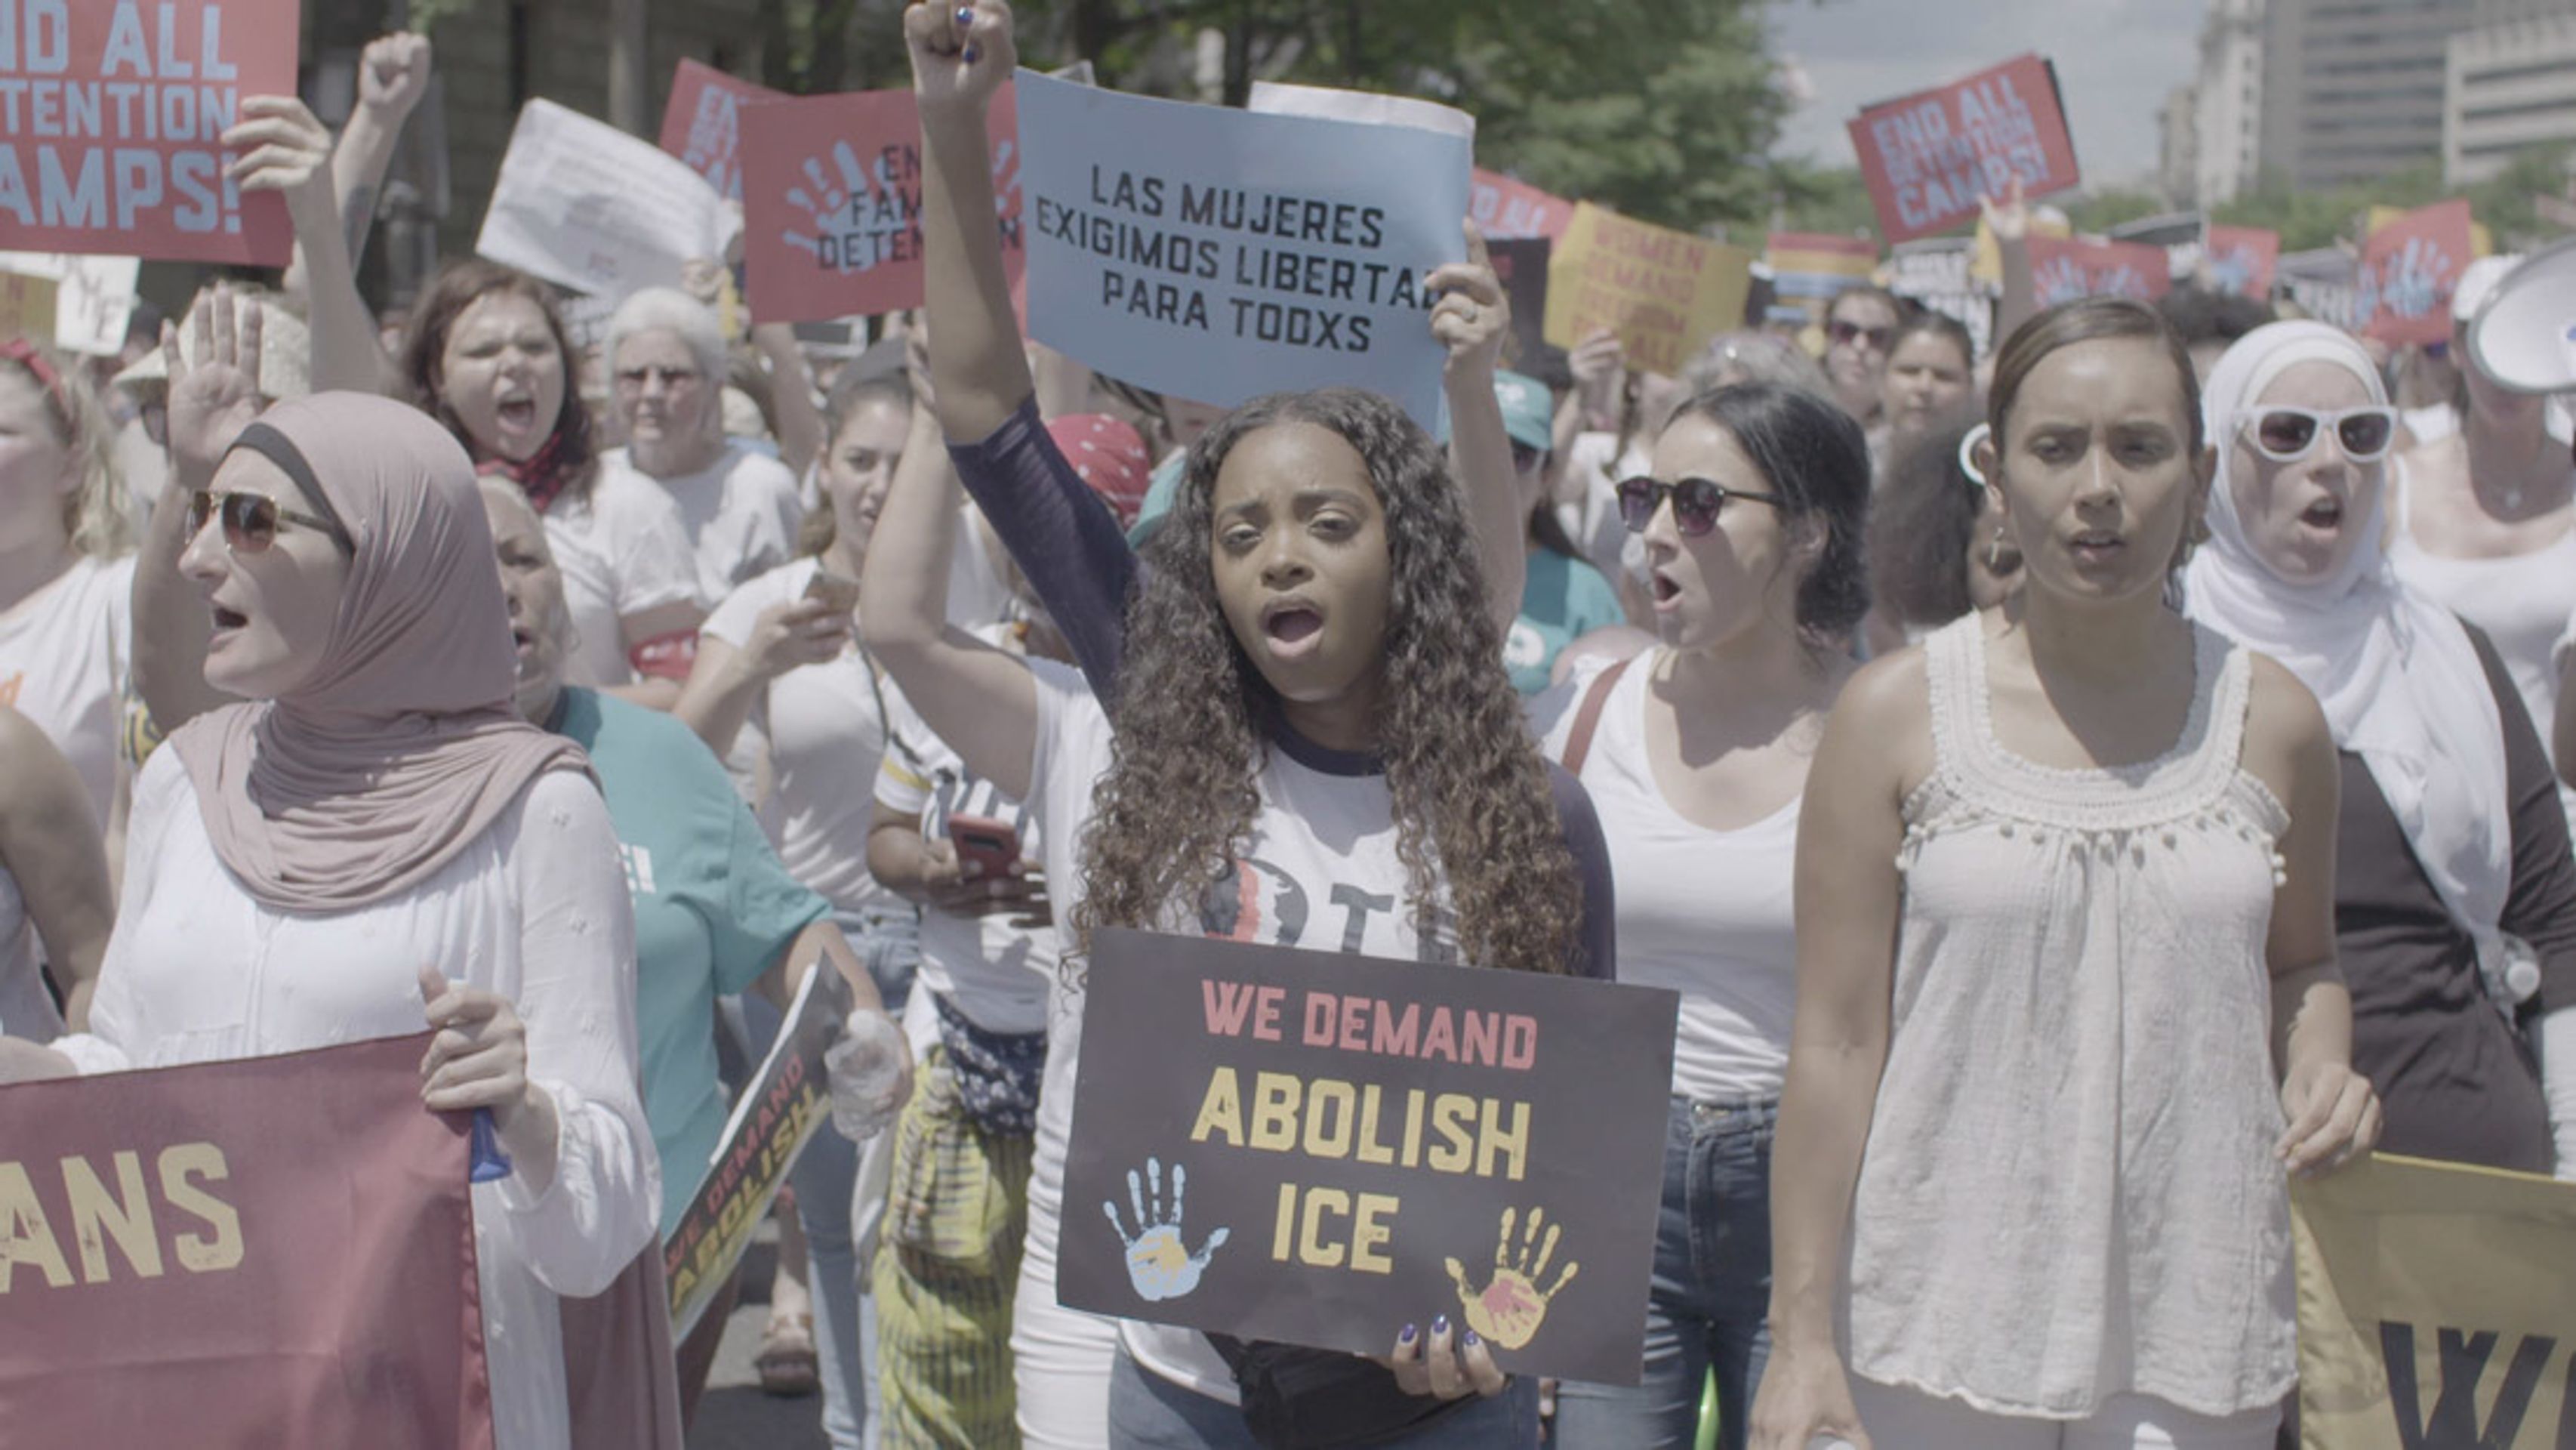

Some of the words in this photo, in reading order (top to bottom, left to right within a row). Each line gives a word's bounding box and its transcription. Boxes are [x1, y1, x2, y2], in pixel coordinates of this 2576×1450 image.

[101, 0, 237, 81] ALL
[1872, 104, 1949, 156] END
[1959, 74, 2031, 125] ALL
[1037, 196, 1219, 279] EXIGIMOS
[1092, 164, 1163, 217] LAS
[1180, 183, 1384, 248] MUJERES
[1102, 269, 1208, 332] PARA
[1229, 297, 1371, 353] TODXS
[1202, 980, 1285, 1042] WE
[1303, 992, 1537, 1069] DEMAND
[707, 1053, 805, 1214] DEMAND
[1190, 1067, 1531, 1181] ABOLISH
[0, 1142, 244, 1294] ANS
[672, 1083, 815, 1313] ABOLISH
[1272, 1183, 1399, 1274] ICE
